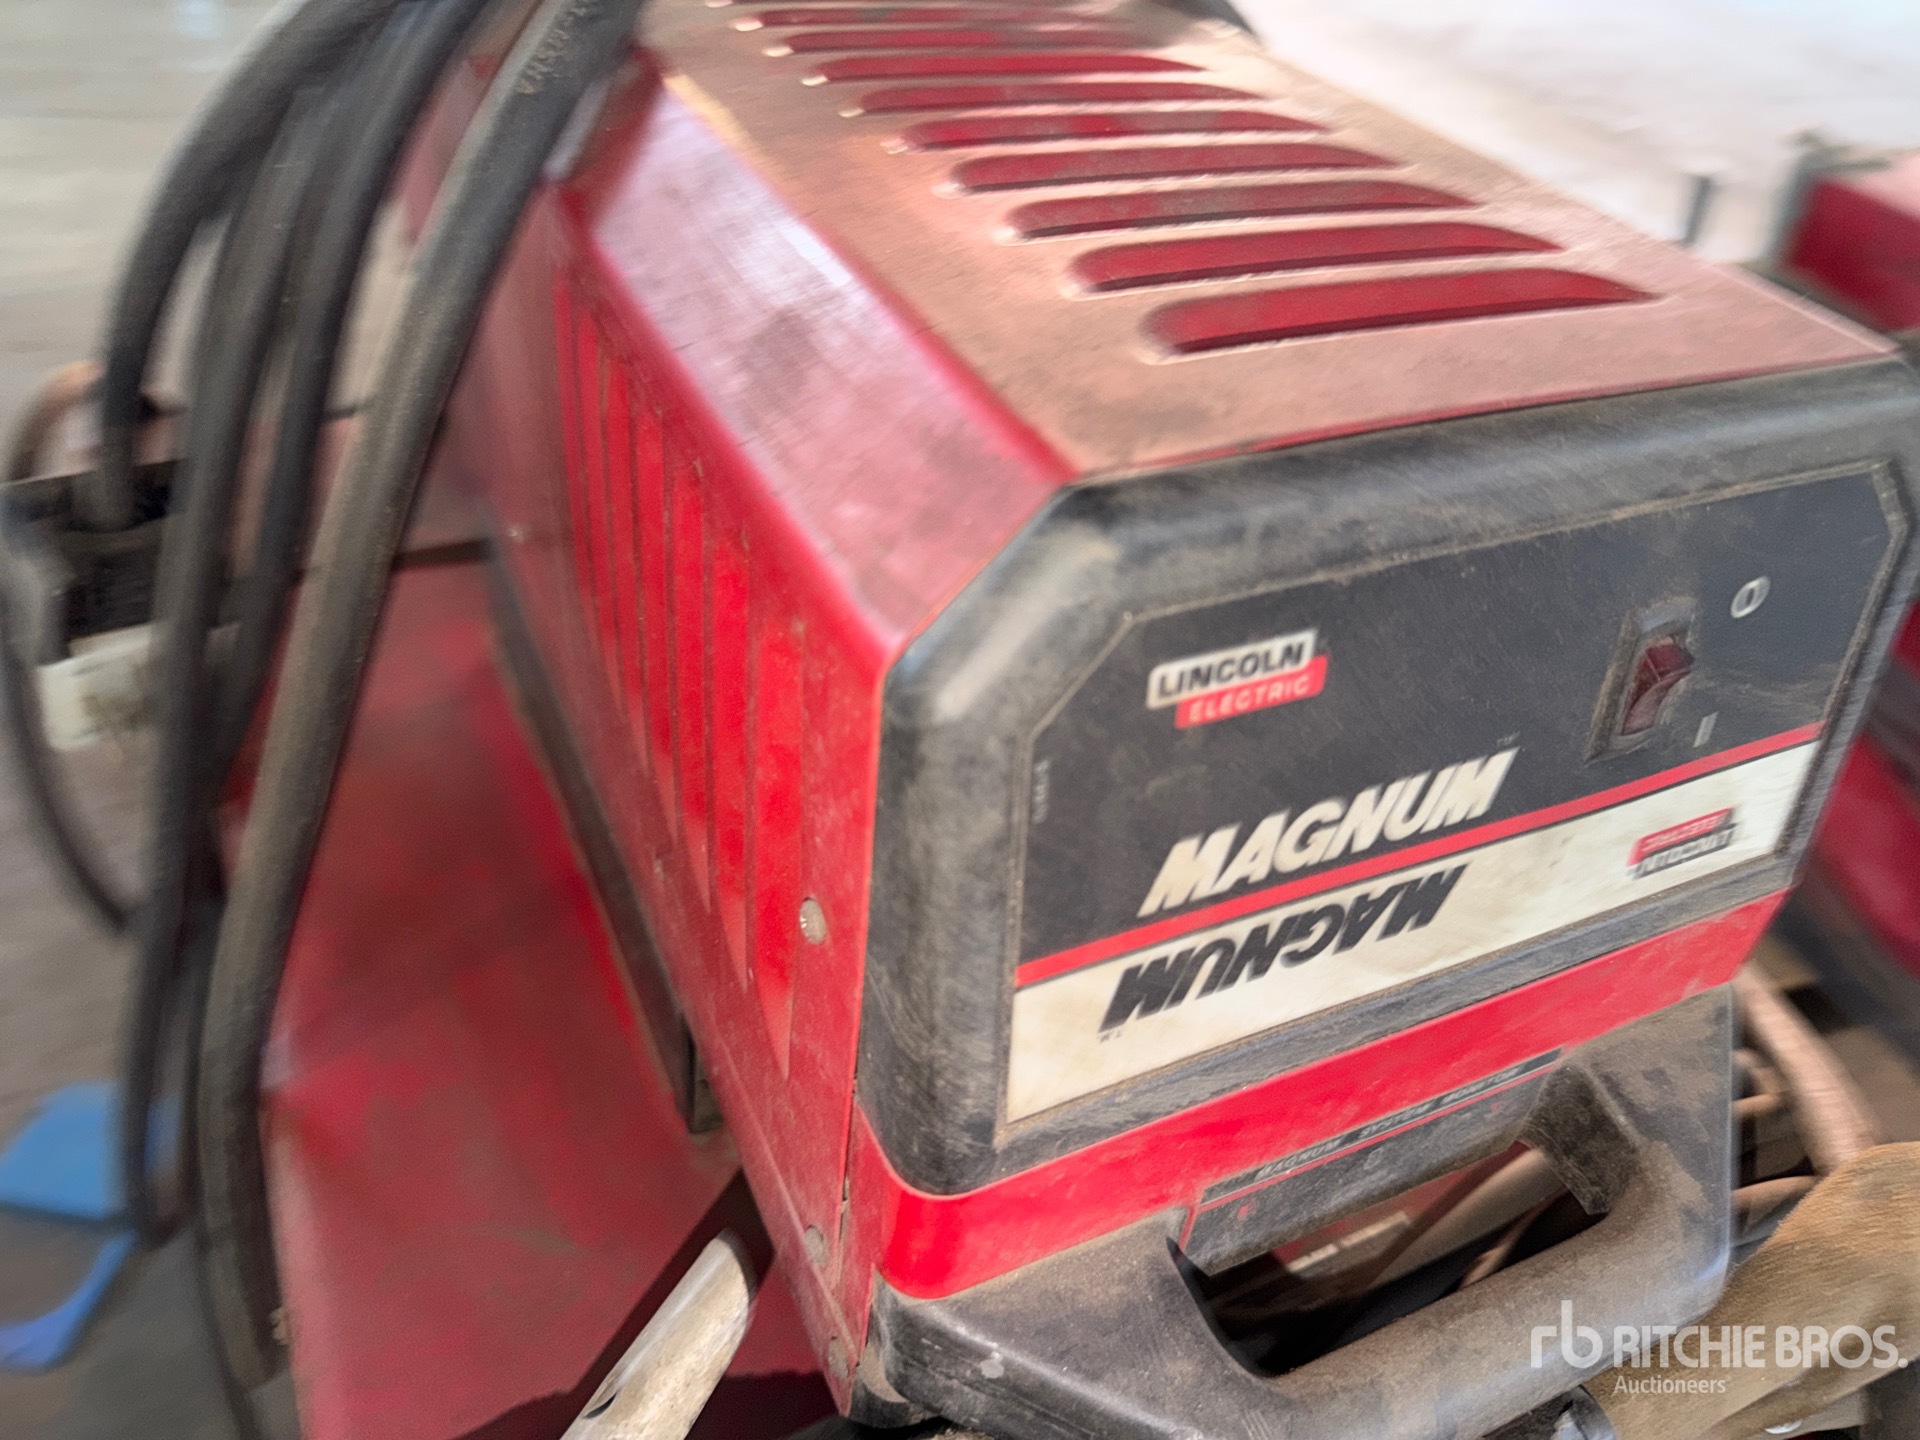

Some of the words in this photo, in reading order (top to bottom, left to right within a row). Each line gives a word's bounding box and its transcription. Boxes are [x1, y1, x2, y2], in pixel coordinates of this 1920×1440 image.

[1157, 640, 1307, 698] LINCOLN
[1187, 675, 1311, 722] ELECTRIC
[1136, 745, 1520, 918] MAGNUM
[1097, 860, 1472, 1034] MAGNUM
[1253, 1138, 1345, 1182] MAGNUM
